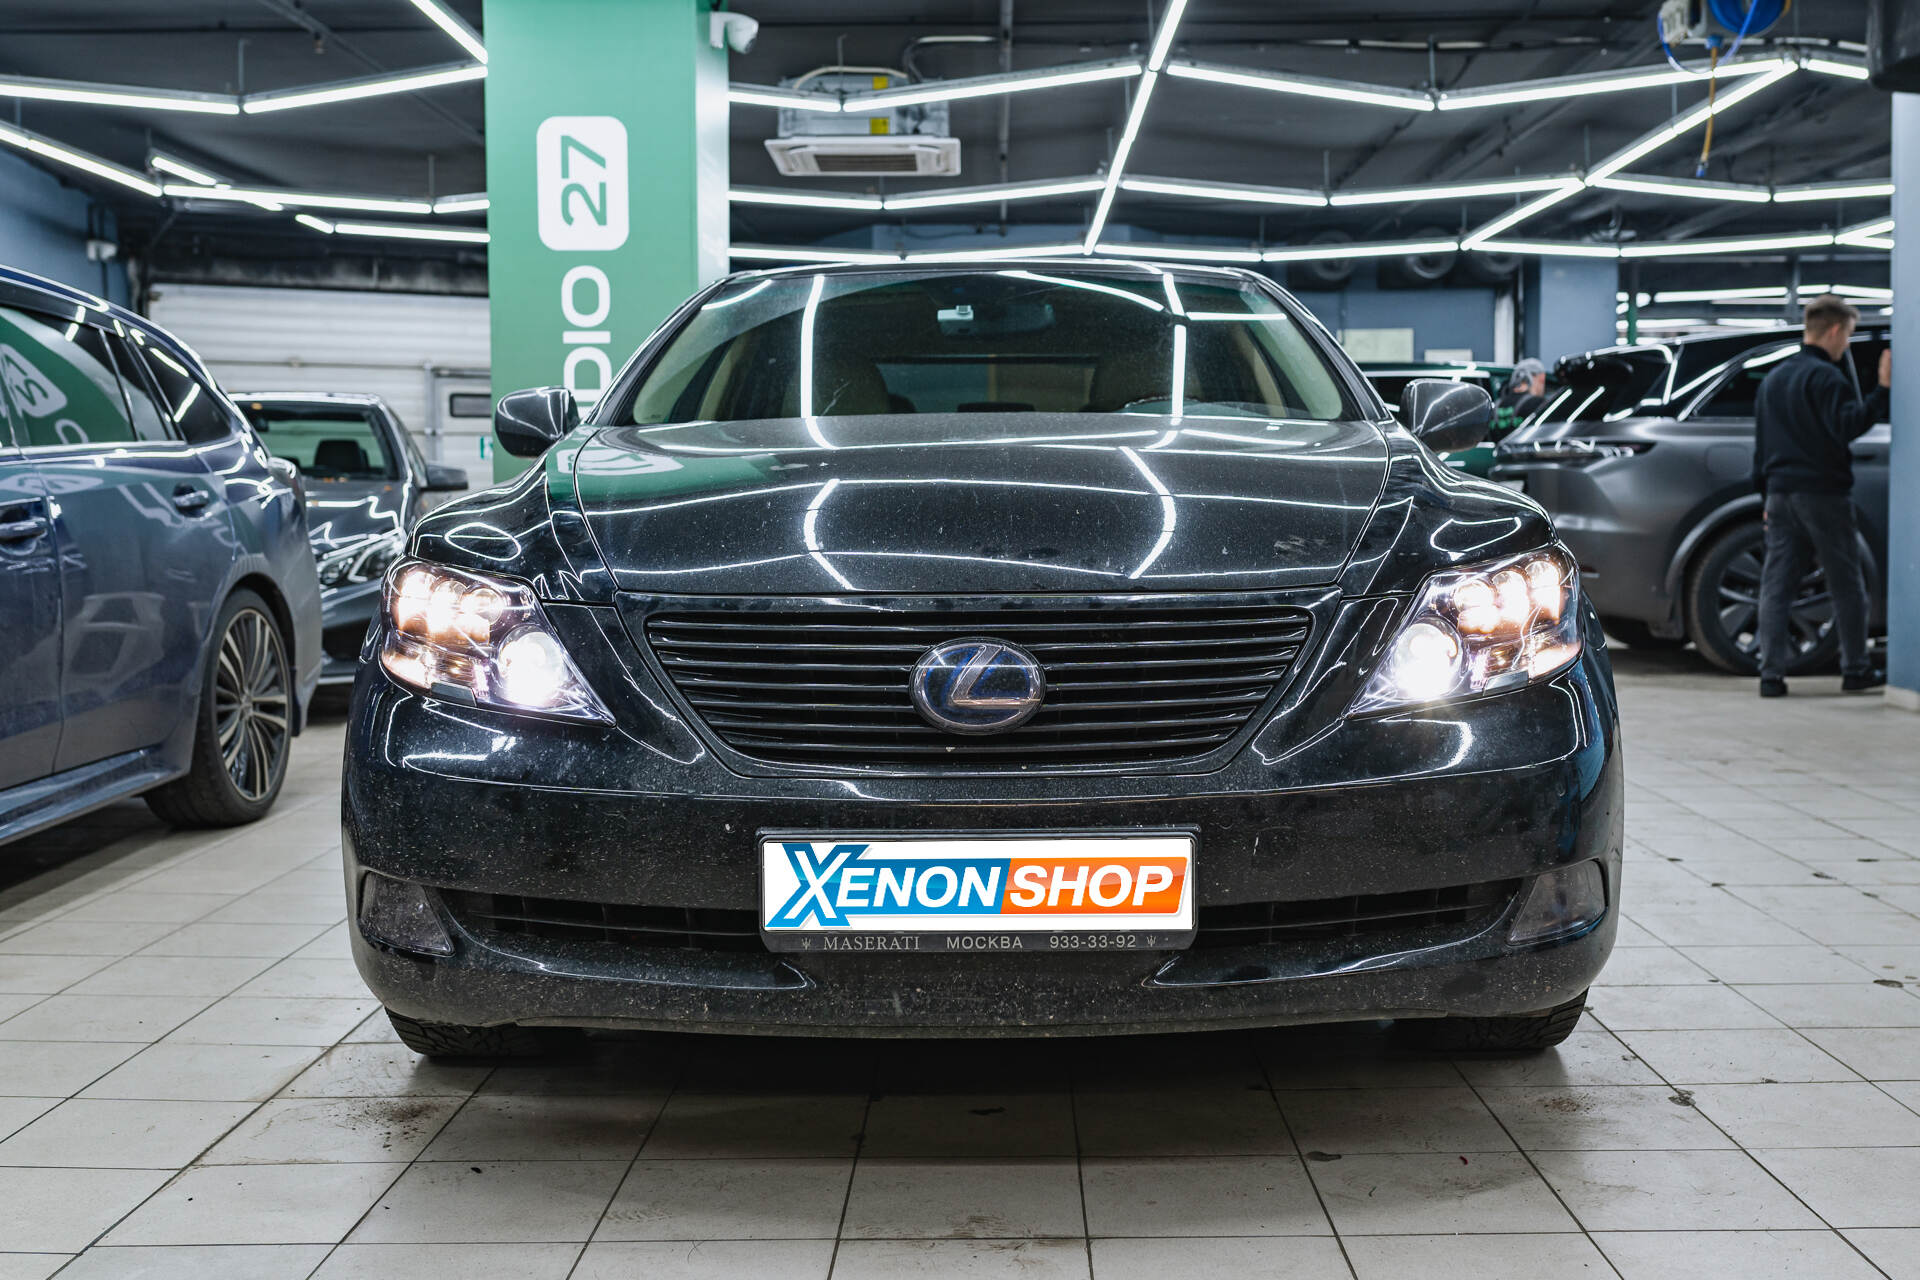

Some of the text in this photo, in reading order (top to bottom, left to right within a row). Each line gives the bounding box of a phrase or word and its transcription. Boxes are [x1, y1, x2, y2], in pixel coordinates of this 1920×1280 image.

[561, 135, 607, 226] 27
[561, 265, 612, 424] DIO
[823, 935, 1137, 950] MASERATI МОСКВА 933-33-92
